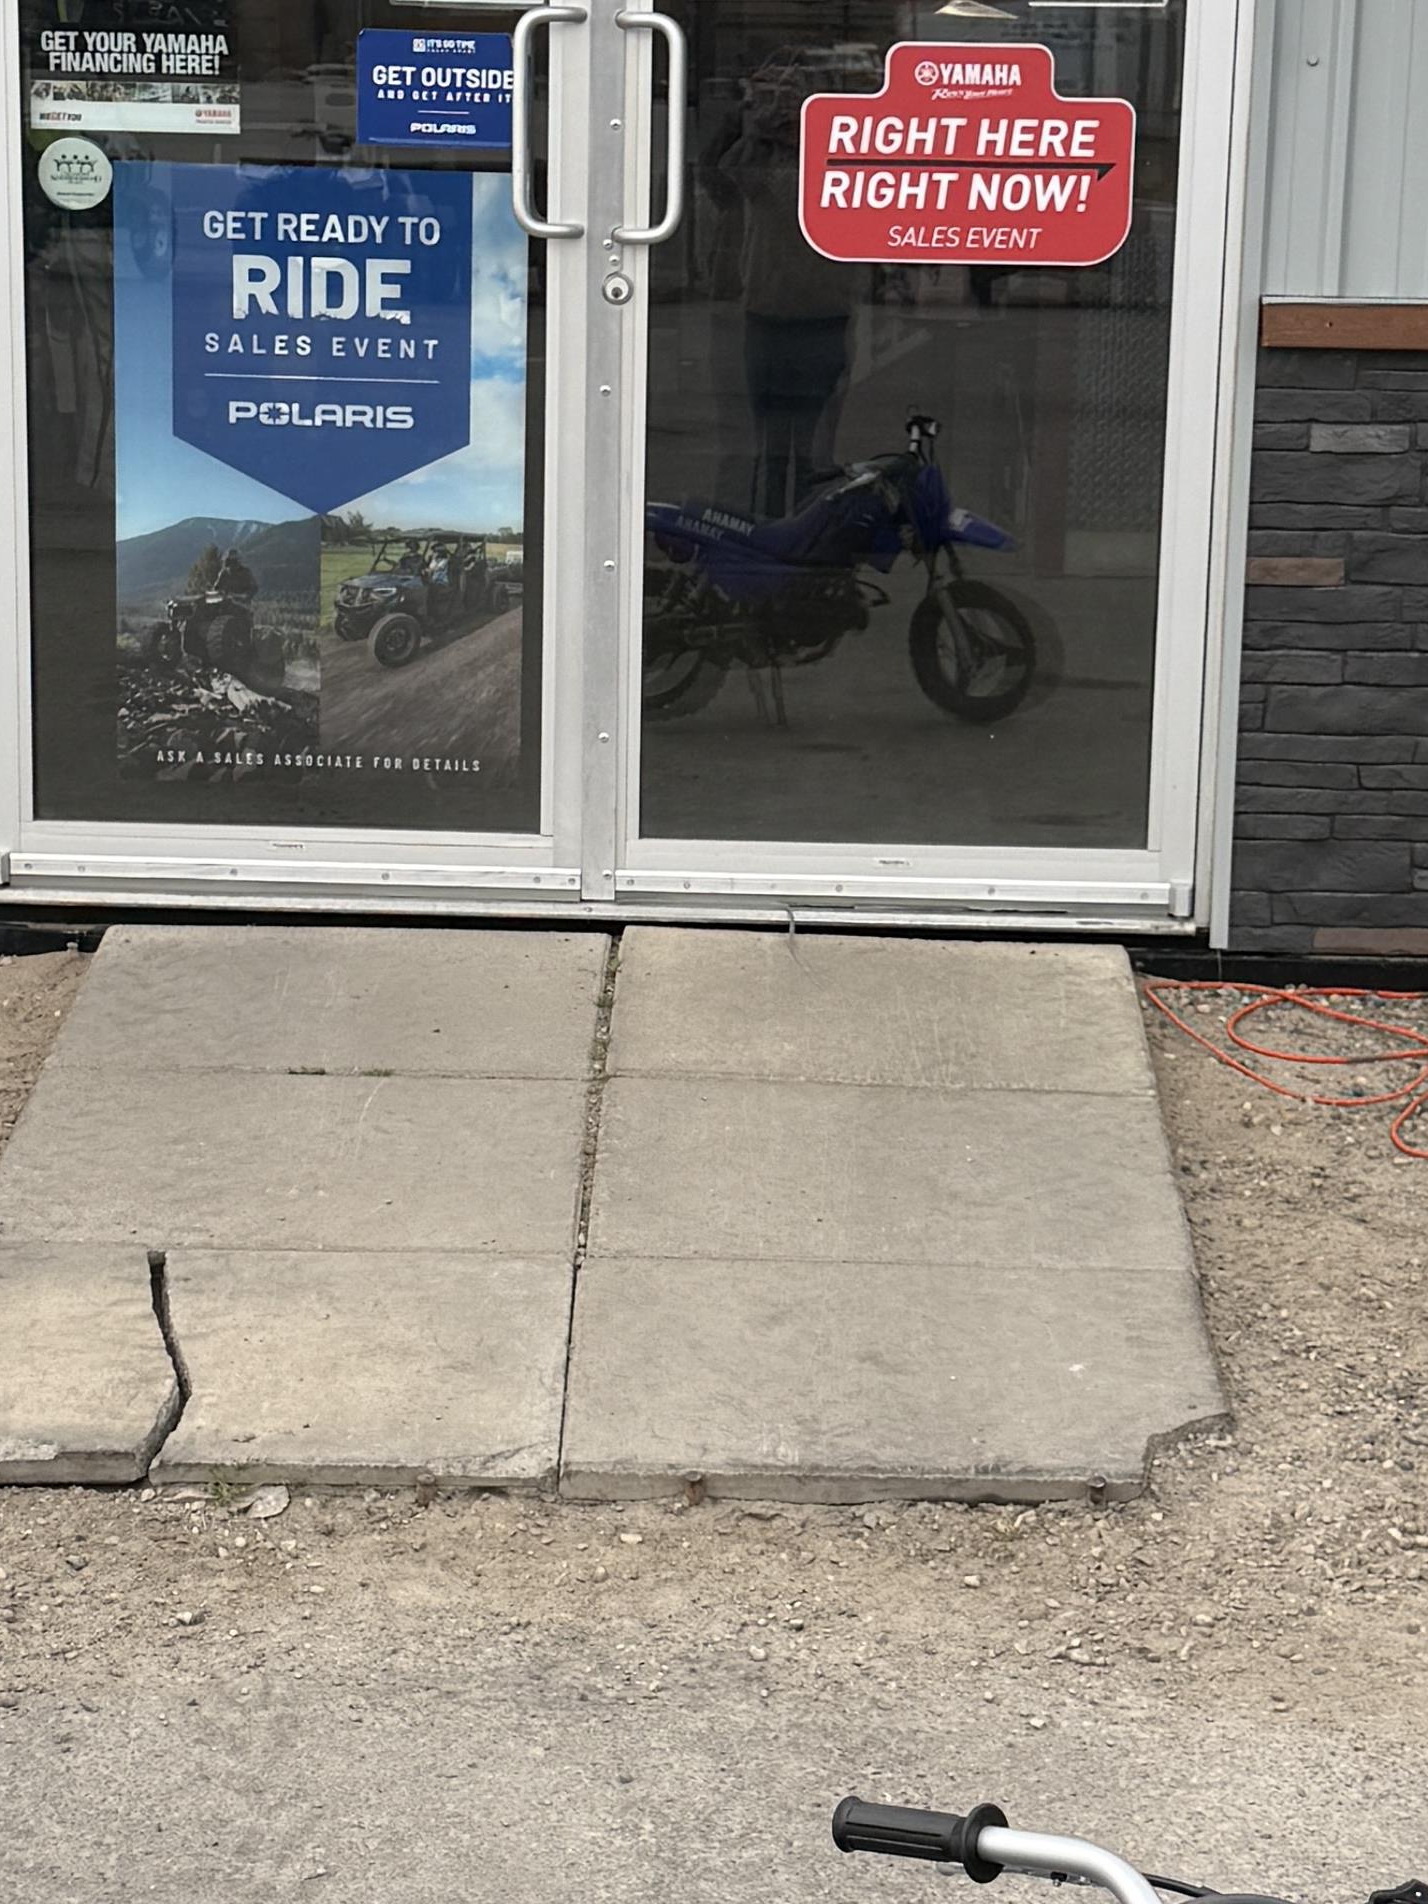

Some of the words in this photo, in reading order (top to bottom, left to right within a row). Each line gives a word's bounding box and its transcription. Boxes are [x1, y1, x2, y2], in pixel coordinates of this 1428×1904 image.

[41, 31, 79, 52] GET
[83, 32, 136, 53] YOUR
[141, 33, 229, 55] YAMAHA
[49, 52, 155, 74] FINANCING
[161, 54, 220, 76] HERE!
[939, 63, 1021, 86] YAMAHA
[372, 65, 417, 86] GET
[421, 67, 514, 90] OUTSIDE
[377, 89, 405, 100] AND
[412, 90, 437, 101] GET
[446, 92, 490, 103] AFTER
[498, 93, 512, 103] IT
[410, 122, 476, 134] POLARIS
[828, 115, 967, 155] RIGHT
[976, 119, 1100, 157] HERE
[820, 170, 959, 210] RIGHT
[968, 173, 1091, 212] NOW!
[203, 210, 268, 240] GET
[277, 212, 390, 244] READY
[397, 216, 440, 246] TO
[887, 225, 960, 247] SALES
[965, 227, 1042, 249] EVENT
[232, 254, 412, 325] RIDE
[205, 333, 312, 356] SALES
[332, 336, 439, 359] EVENT
[228, 401, 414, 429] POLARIS
[157, 750, 186, 762] ASK
[196, 751, 204, 763] A
[214, 752, 264, 765] SALES
[274, 754, 363, 768] ASSOCIATE
[373, 757, 403, 770] FOR
[412, 757, 481, 772] DETAILS
